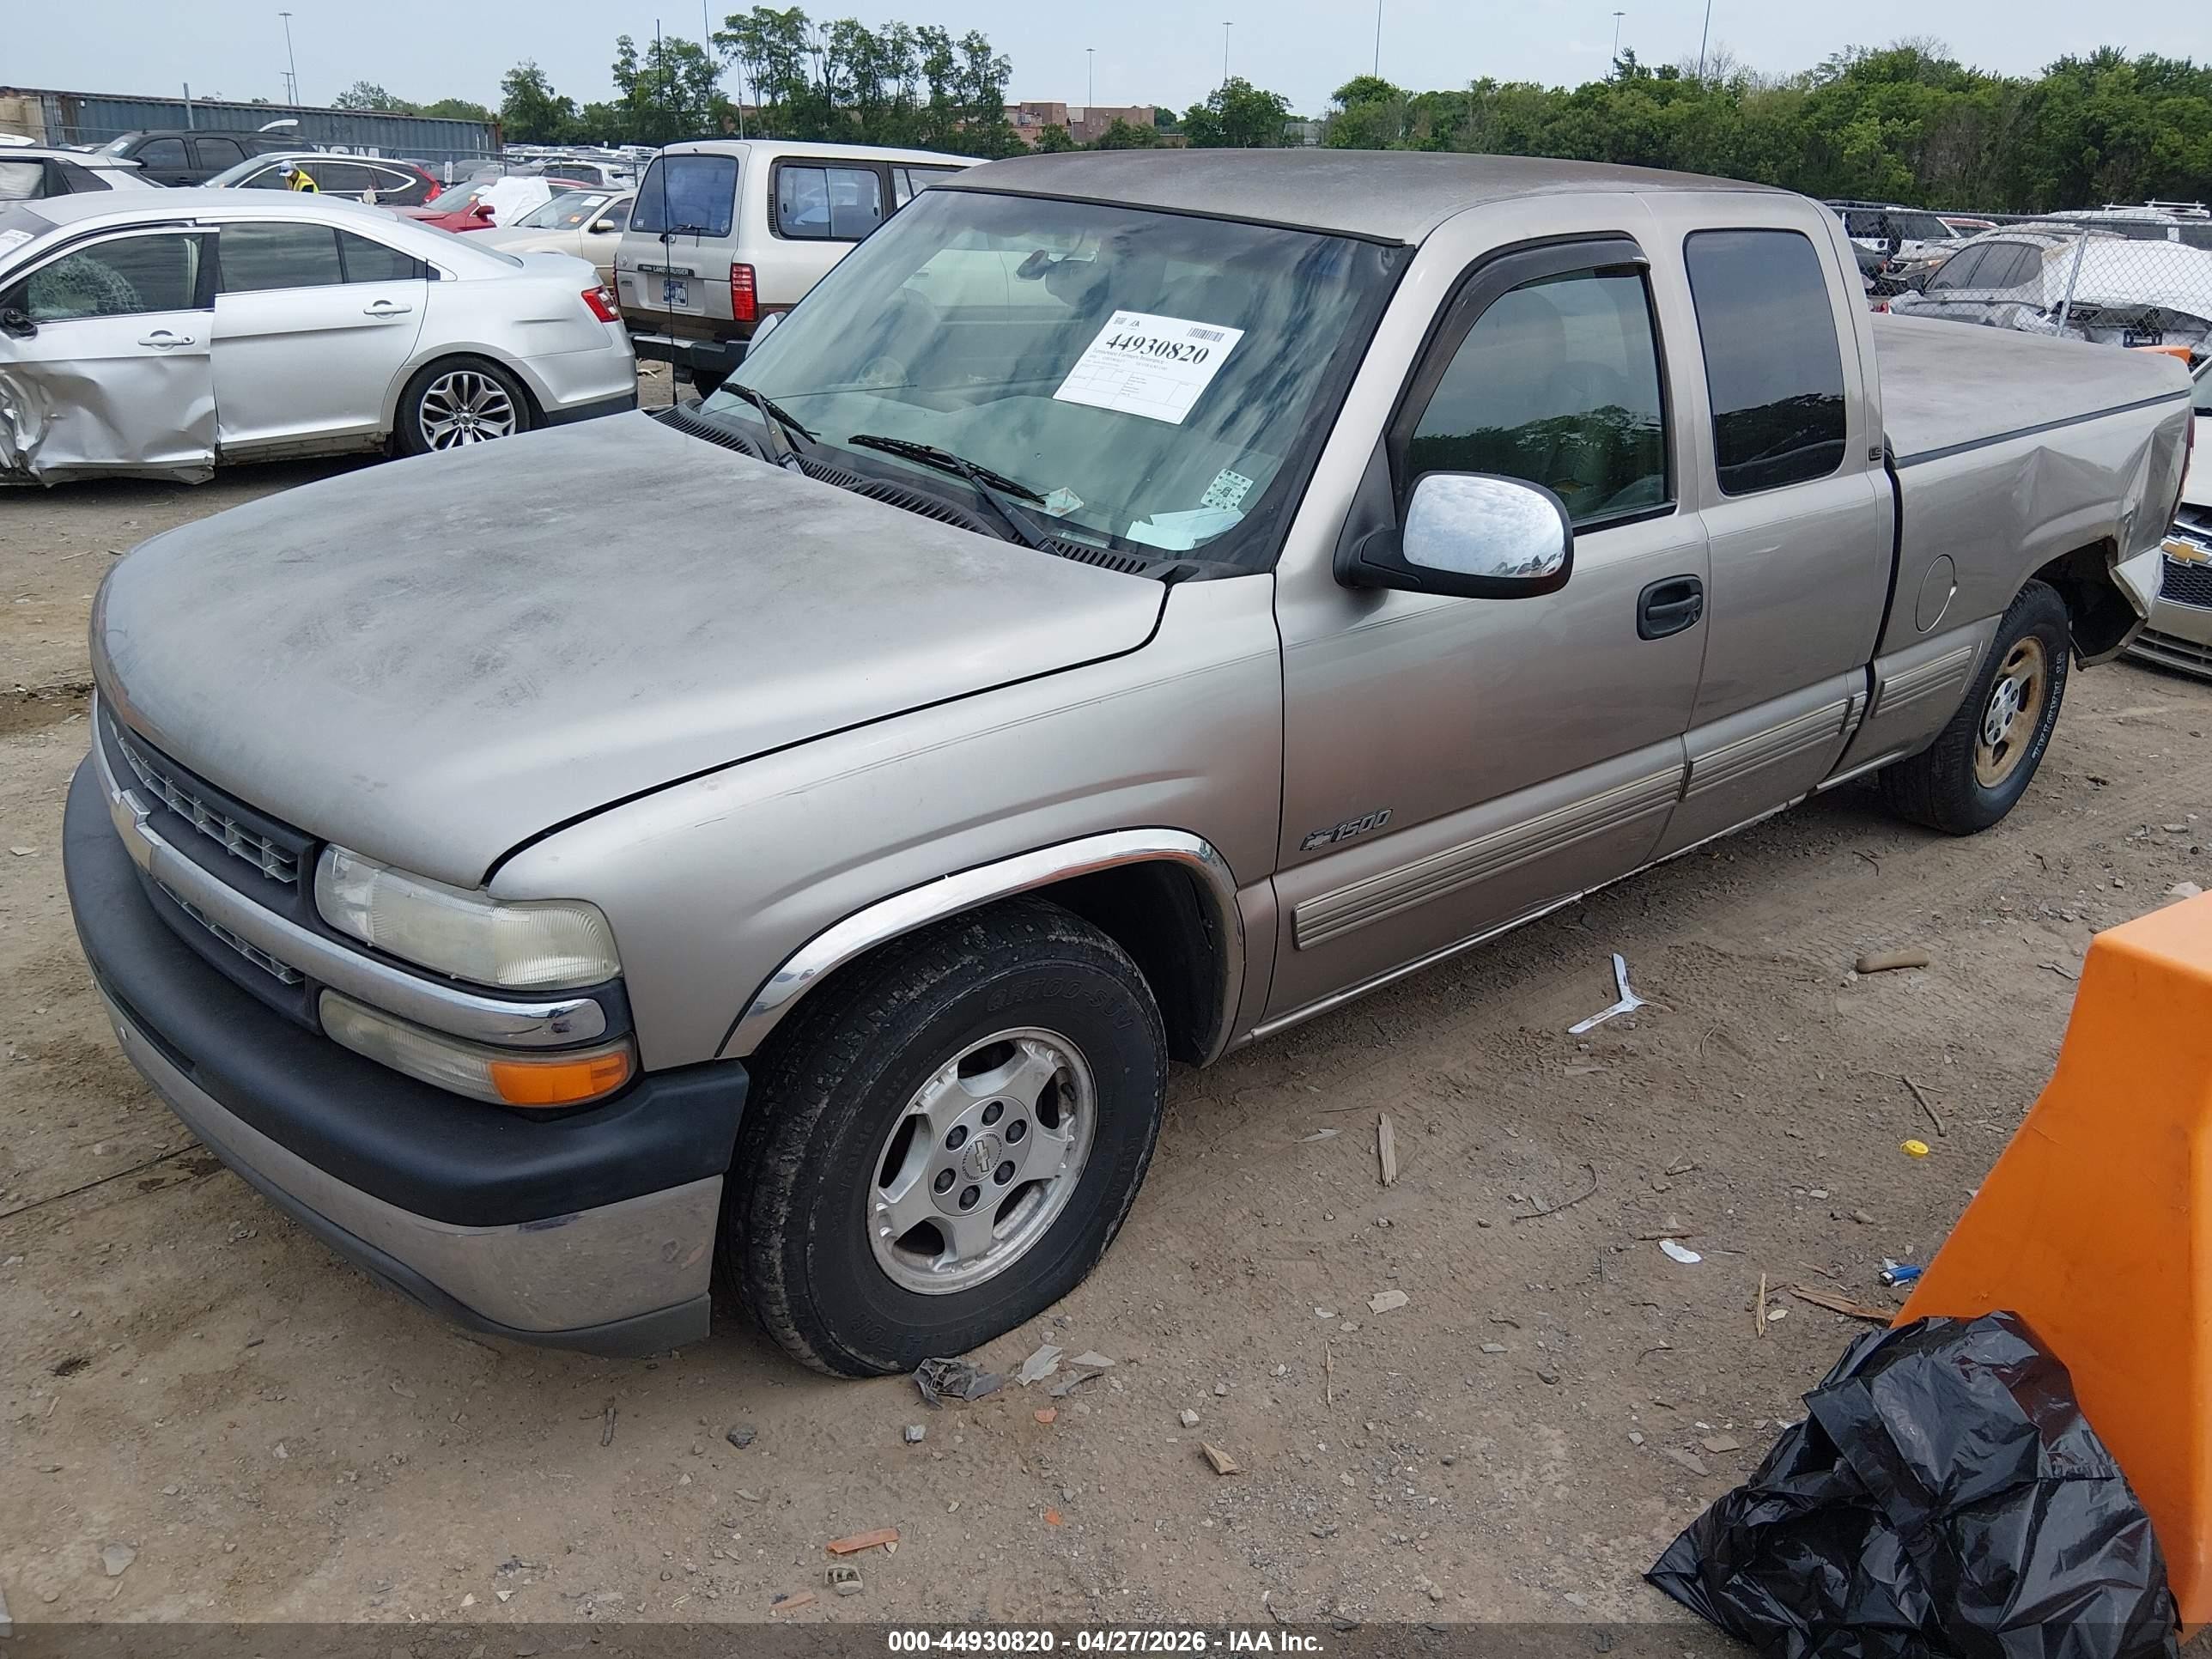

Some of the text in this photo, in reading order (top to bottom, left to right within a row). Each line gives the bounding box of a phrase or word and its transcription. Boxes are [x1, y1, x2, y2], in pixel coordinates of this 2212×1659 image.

[1106, 332, 1210, 365] 44930820
[1869, 447, 1882, 459] LS
[1334, 809, 1393, 842] 1500
